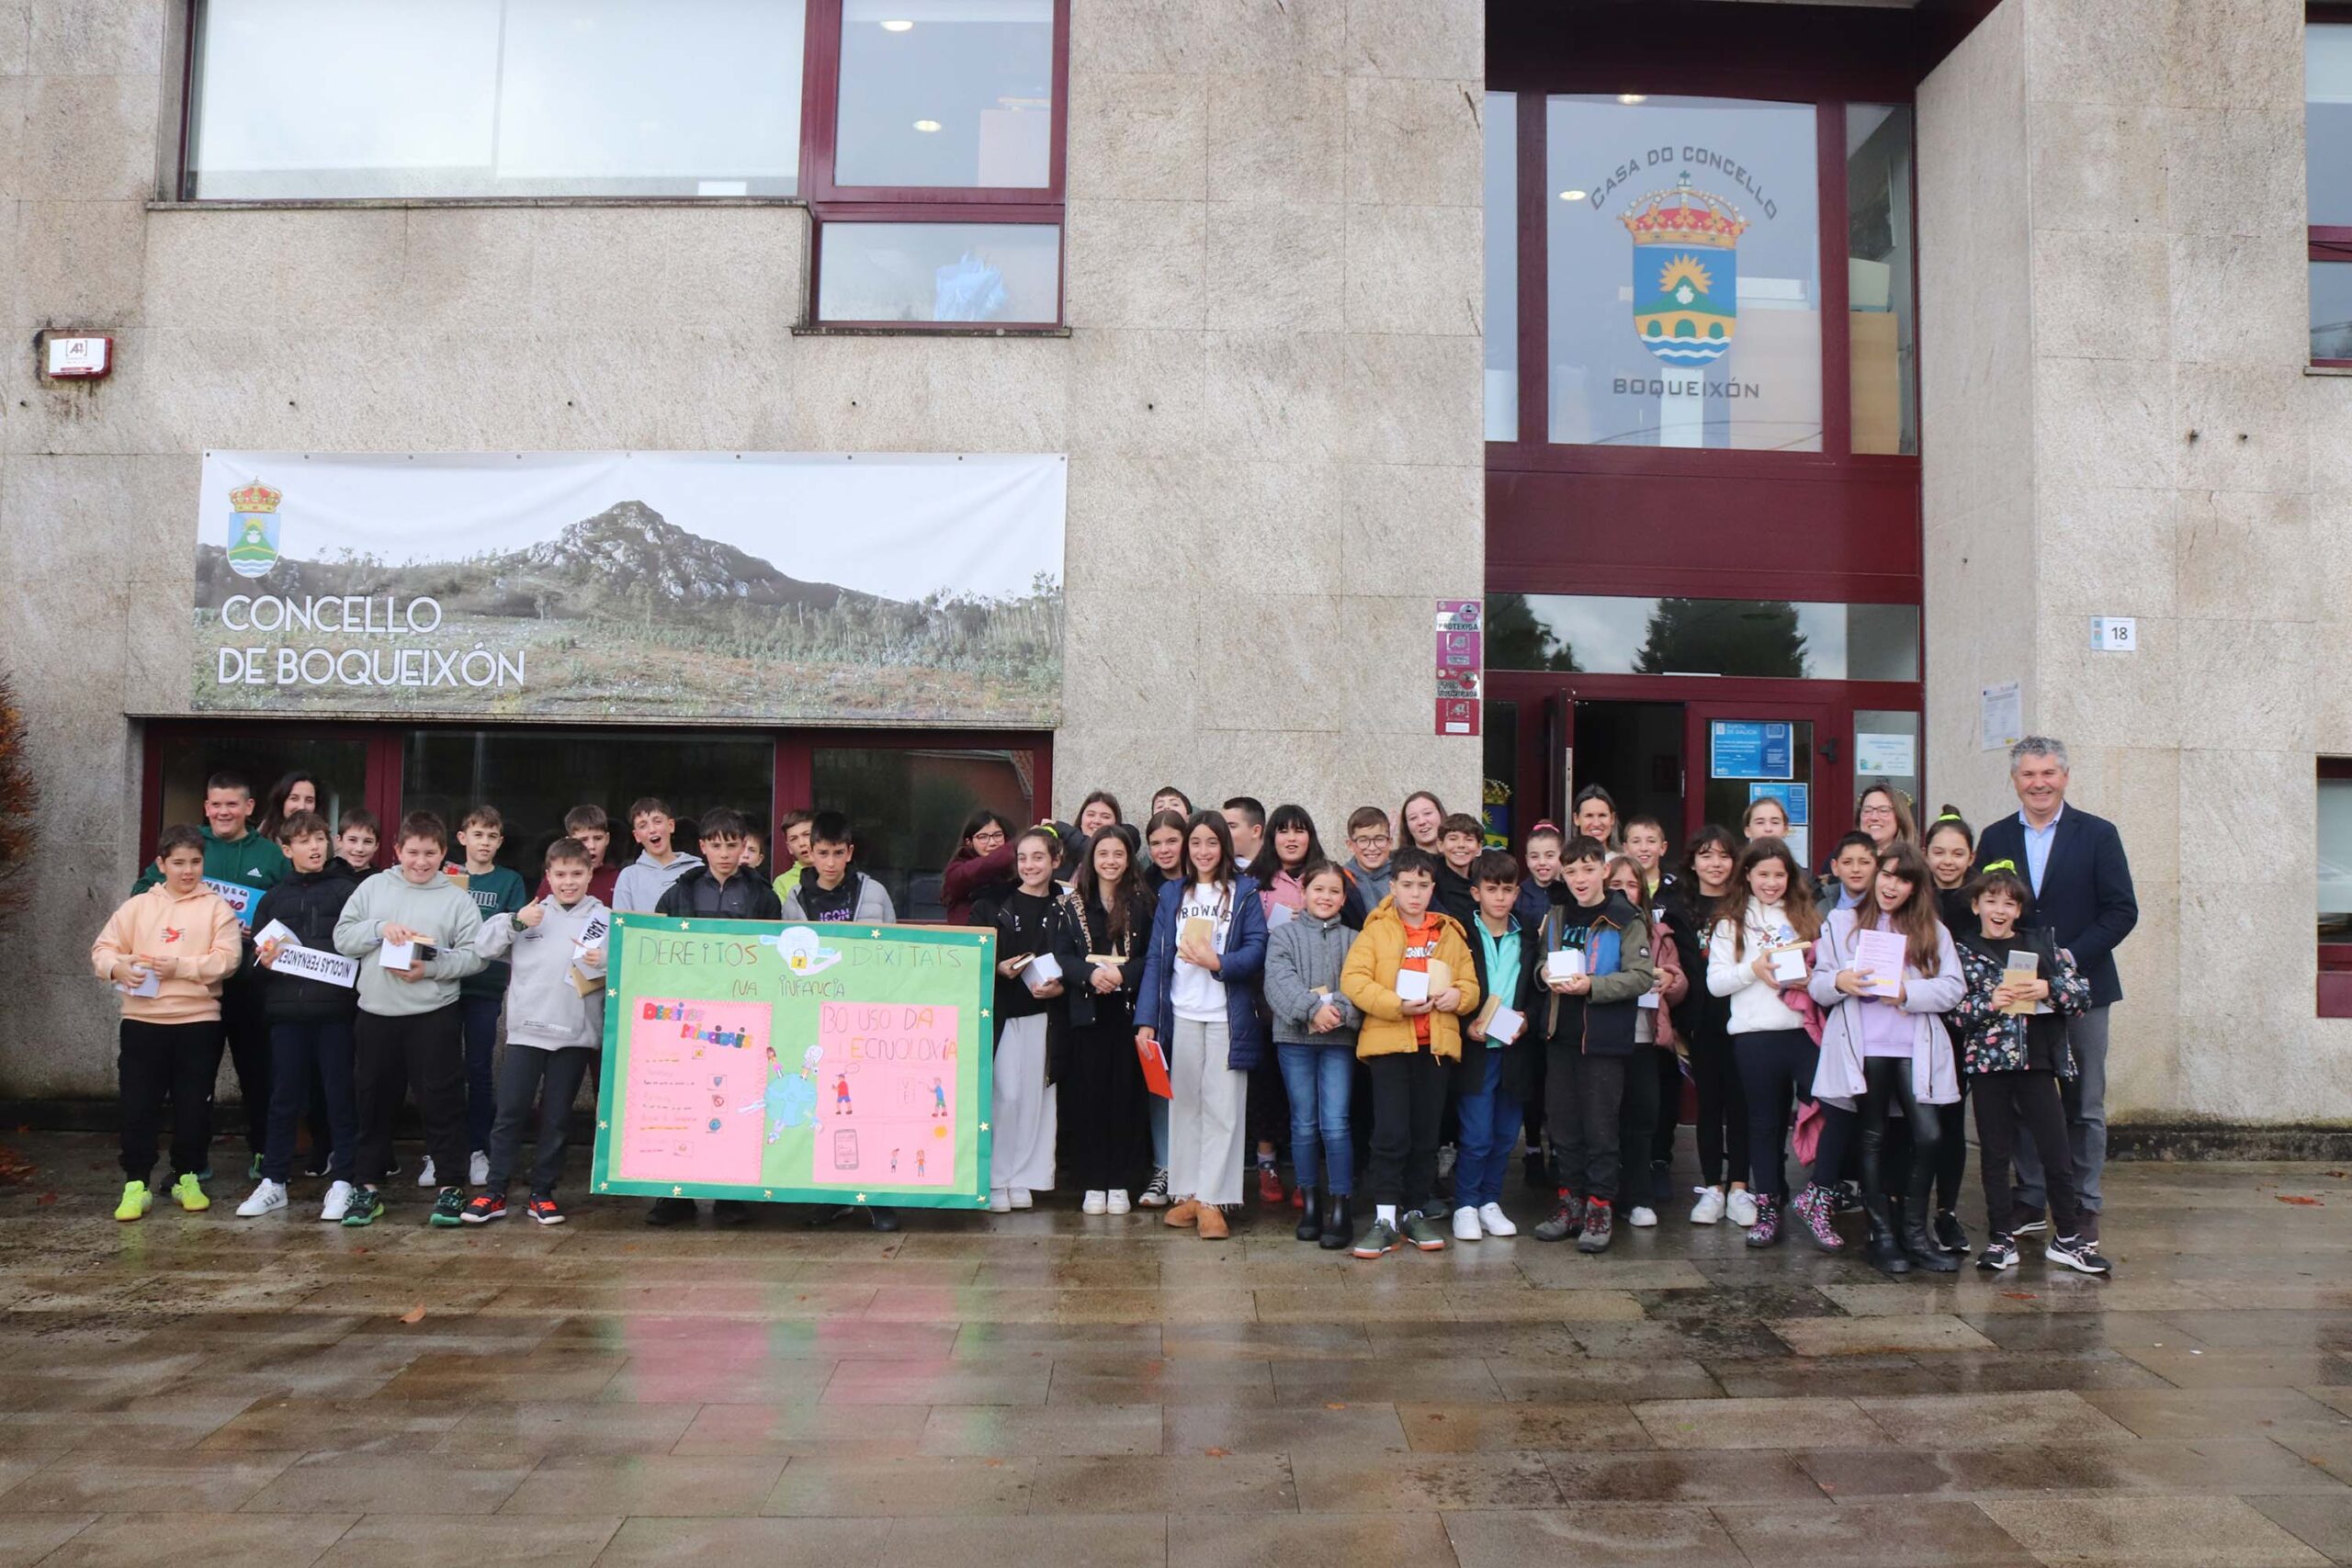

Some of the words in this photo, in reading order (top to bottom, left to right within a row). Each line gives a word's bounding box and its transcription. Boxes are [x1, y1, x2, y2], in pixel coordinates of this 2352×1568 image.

[1589, 159, 1641, 211] CASA
[1647, 146, 1674, 166] DO
[1682, 145, 1778, 220] CONCELLO
[1612, 376, 1760, 400] BOQUEIXÓN
[220, 594, 443, 634] CONCELLO
[2111, 626, 2129, 640] 18
[217, 647, 268, 684] DE
[276, 641, 526, 688] BOQUEIXÓN
[731, 978, 758, 998] NA
[903, 1007, 934, 1031] DA
